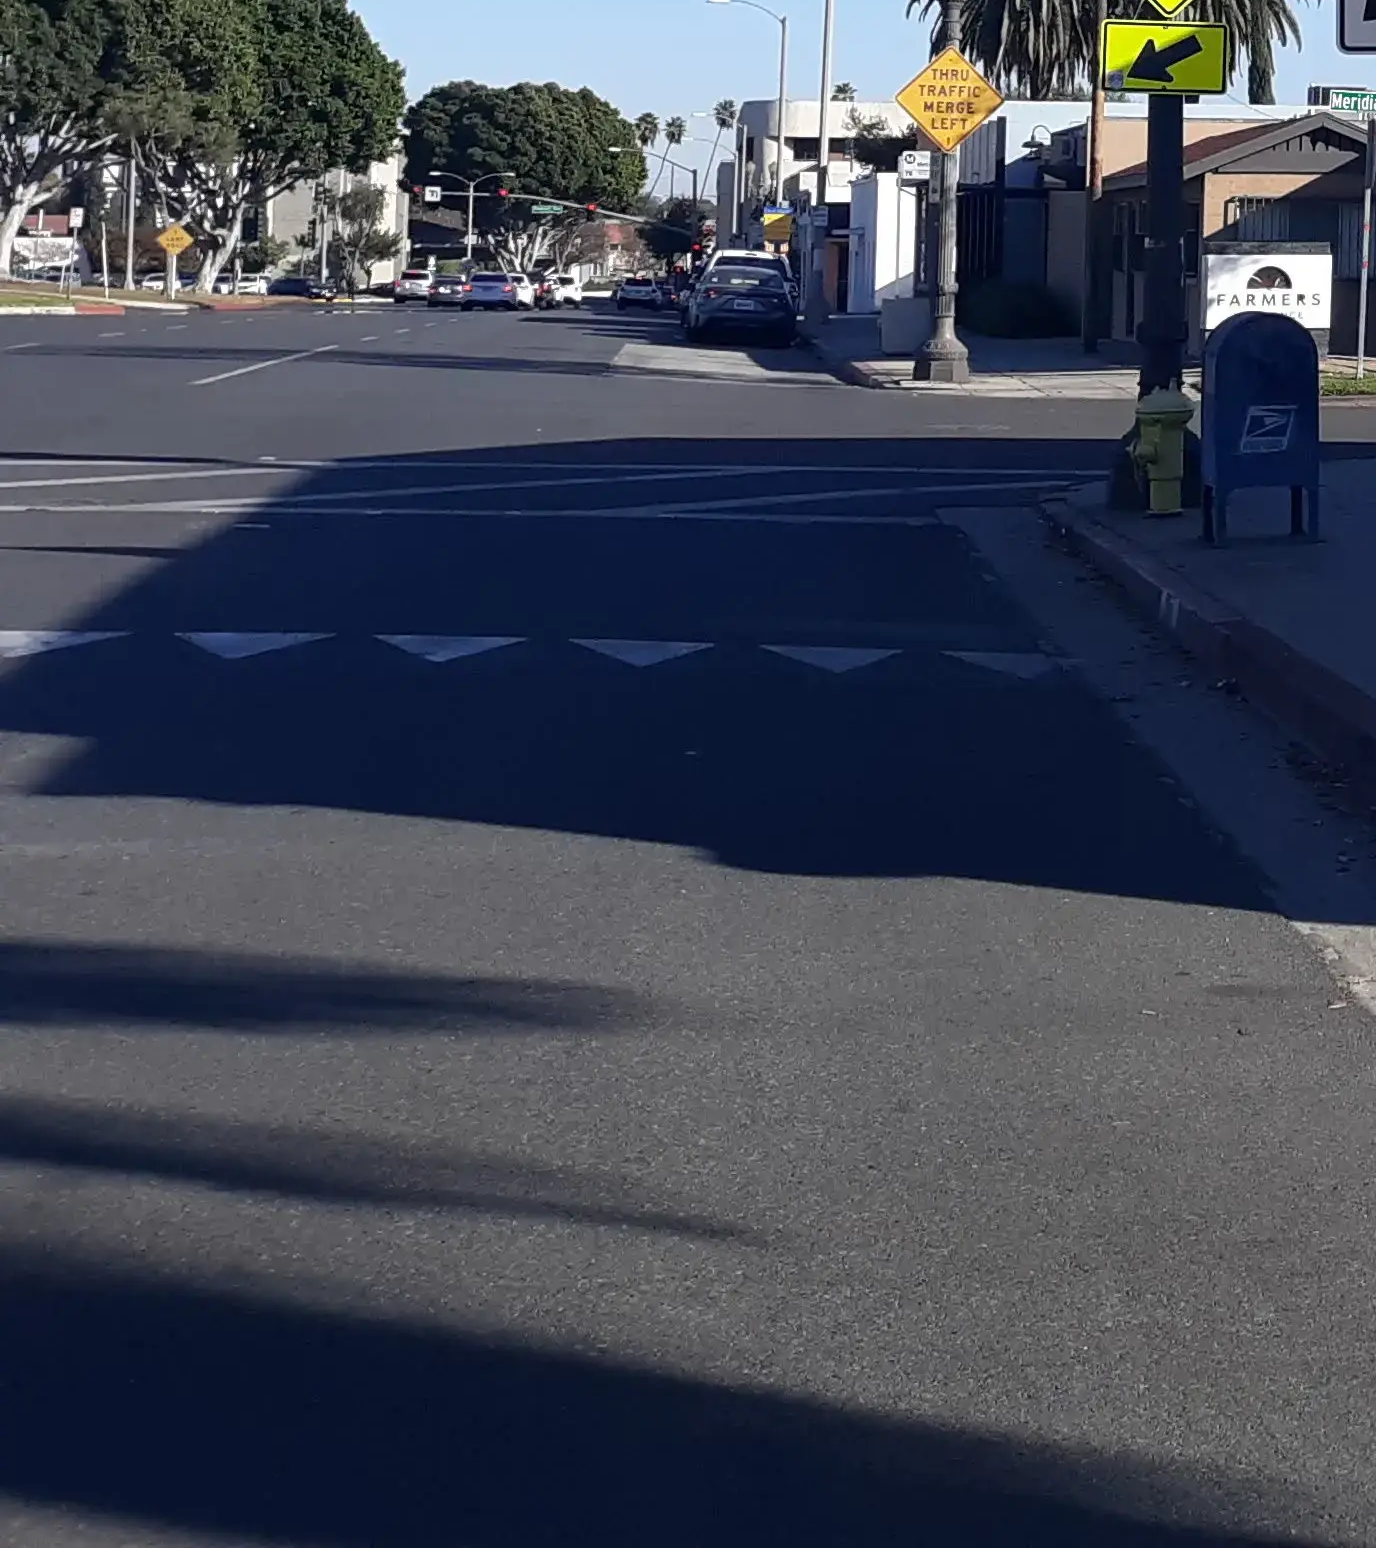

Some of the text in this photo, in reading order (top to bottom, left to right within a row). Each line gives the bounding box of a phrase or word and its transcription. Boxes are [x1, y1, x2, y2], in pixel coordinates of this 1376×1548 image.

[932, 69, 969, 81] THRU
[919, 85, 981, 97] TRAFFIC
[923, 101, 976, 114] MERGE
[930, 117, 969, 130] LEFT
[1216, 293, 1321, 306] FARMERS
